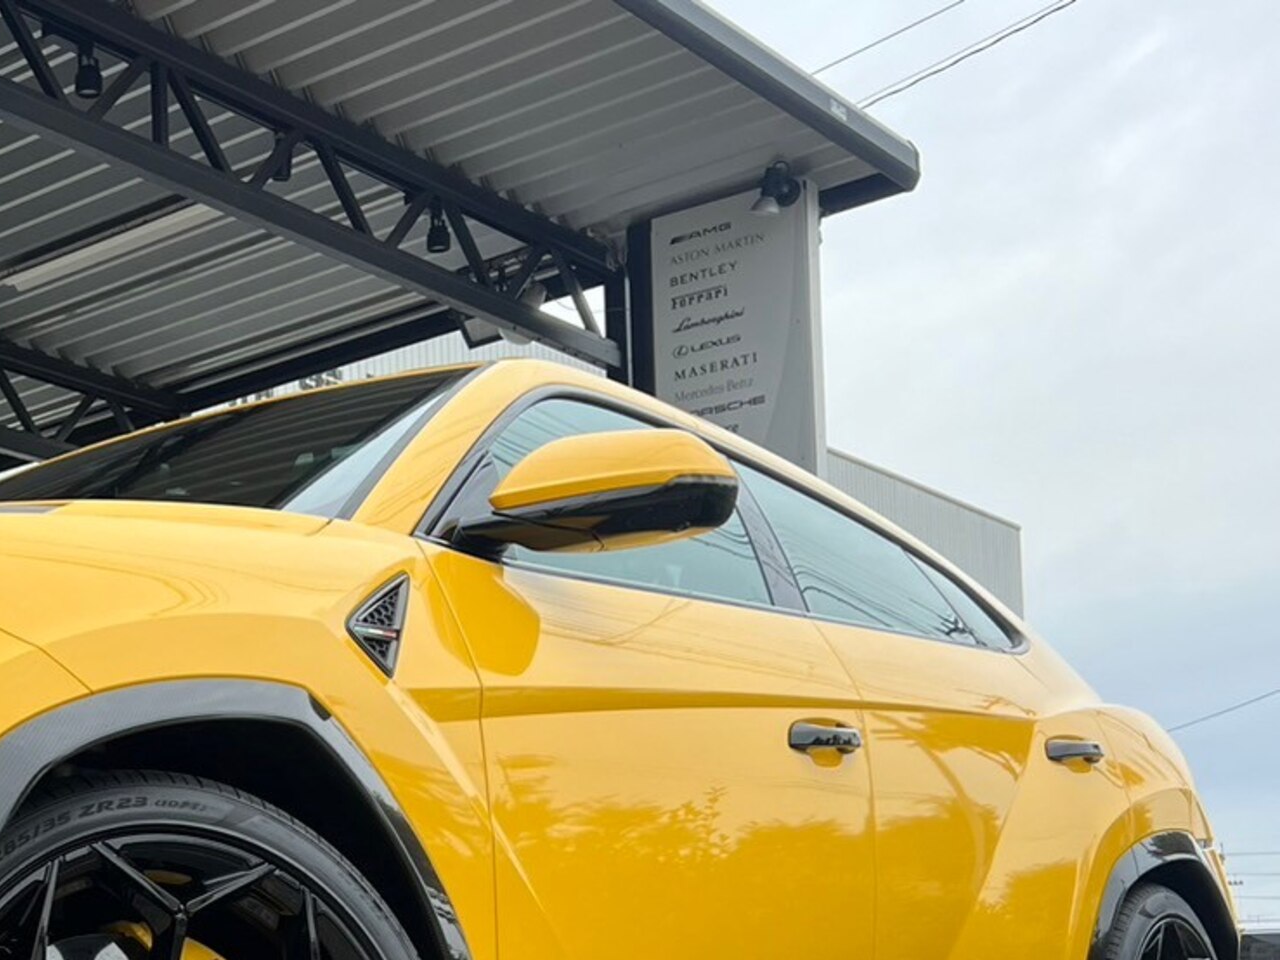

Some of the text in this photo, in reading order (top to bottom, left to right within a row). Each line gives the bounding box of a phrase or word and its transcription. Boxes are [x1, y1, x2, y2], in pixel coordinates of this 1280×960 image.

[687, 222, 732, 240] AMG
[671, 232, 766, 265] ASTON MARTIN
[670, 260, 738, 287] BENTLEY
[671, 284, 728, 309] Ferrari
[672, 307, 745, 333] Lamborghini
[690, 334, 741, 352] LEXUS
[674, 352, 758, 381] MASERATI
[78, 796, 149, 819] ZR23
